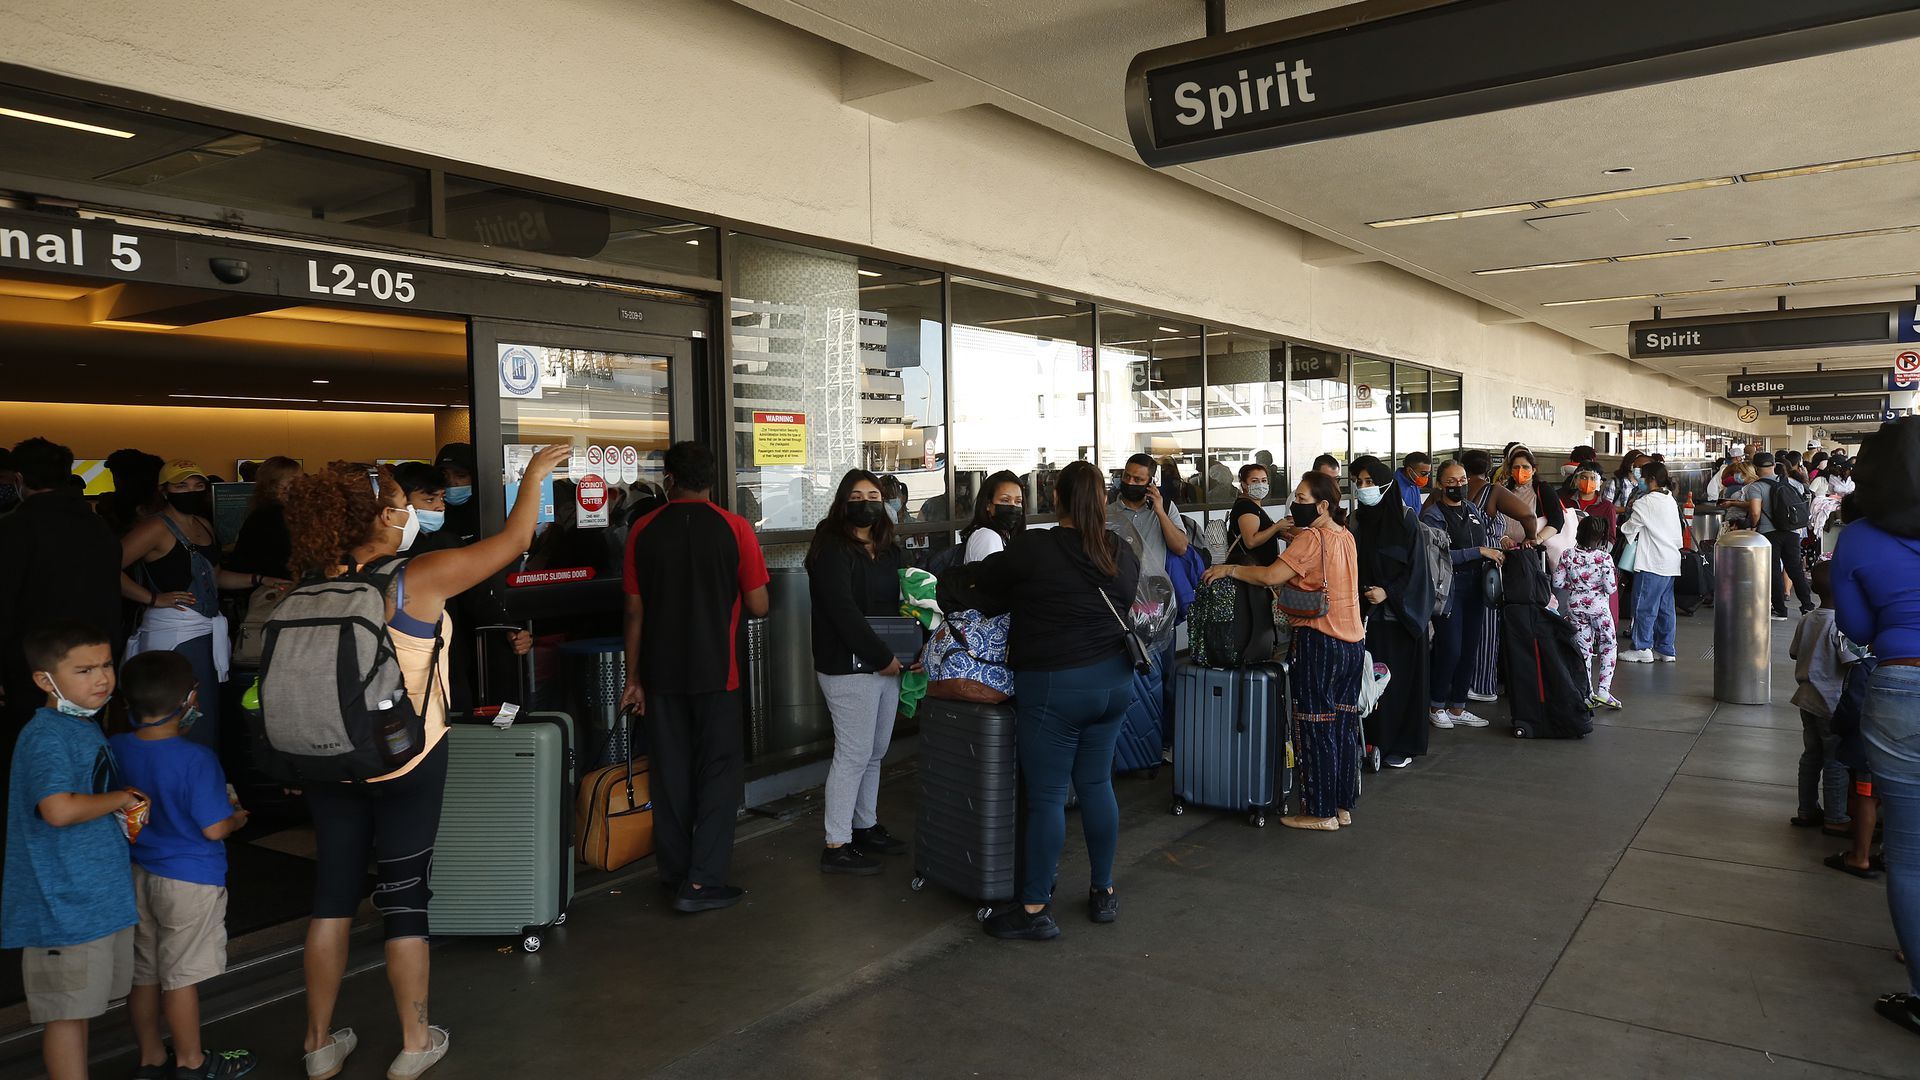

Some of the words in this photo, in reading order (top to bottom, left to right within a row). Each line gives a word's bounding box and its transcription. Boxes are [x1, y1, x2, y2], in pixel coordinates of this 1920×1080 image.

[1174, 59, 1316, 130] Spirit
[111, 233, 142, 272] 5
[308, 260, 416, 303] L2-05
[1646, 331, 1701, 350] Spirit
[1737, 382, 1785, 393] JetBlue
[1776, 403, 1810, 412] JetBlue
[1792, 414, 1821, 423] JetBlue
[1823, 412, 1875, 422] Mosaic/Mint
[1886, 410, 1896, 420] 5
[516, 573, 548, 584] AUTOMATIC
[549, 571, 571, 580] SLIDING
[571, 570, 587, 578] DOOR
